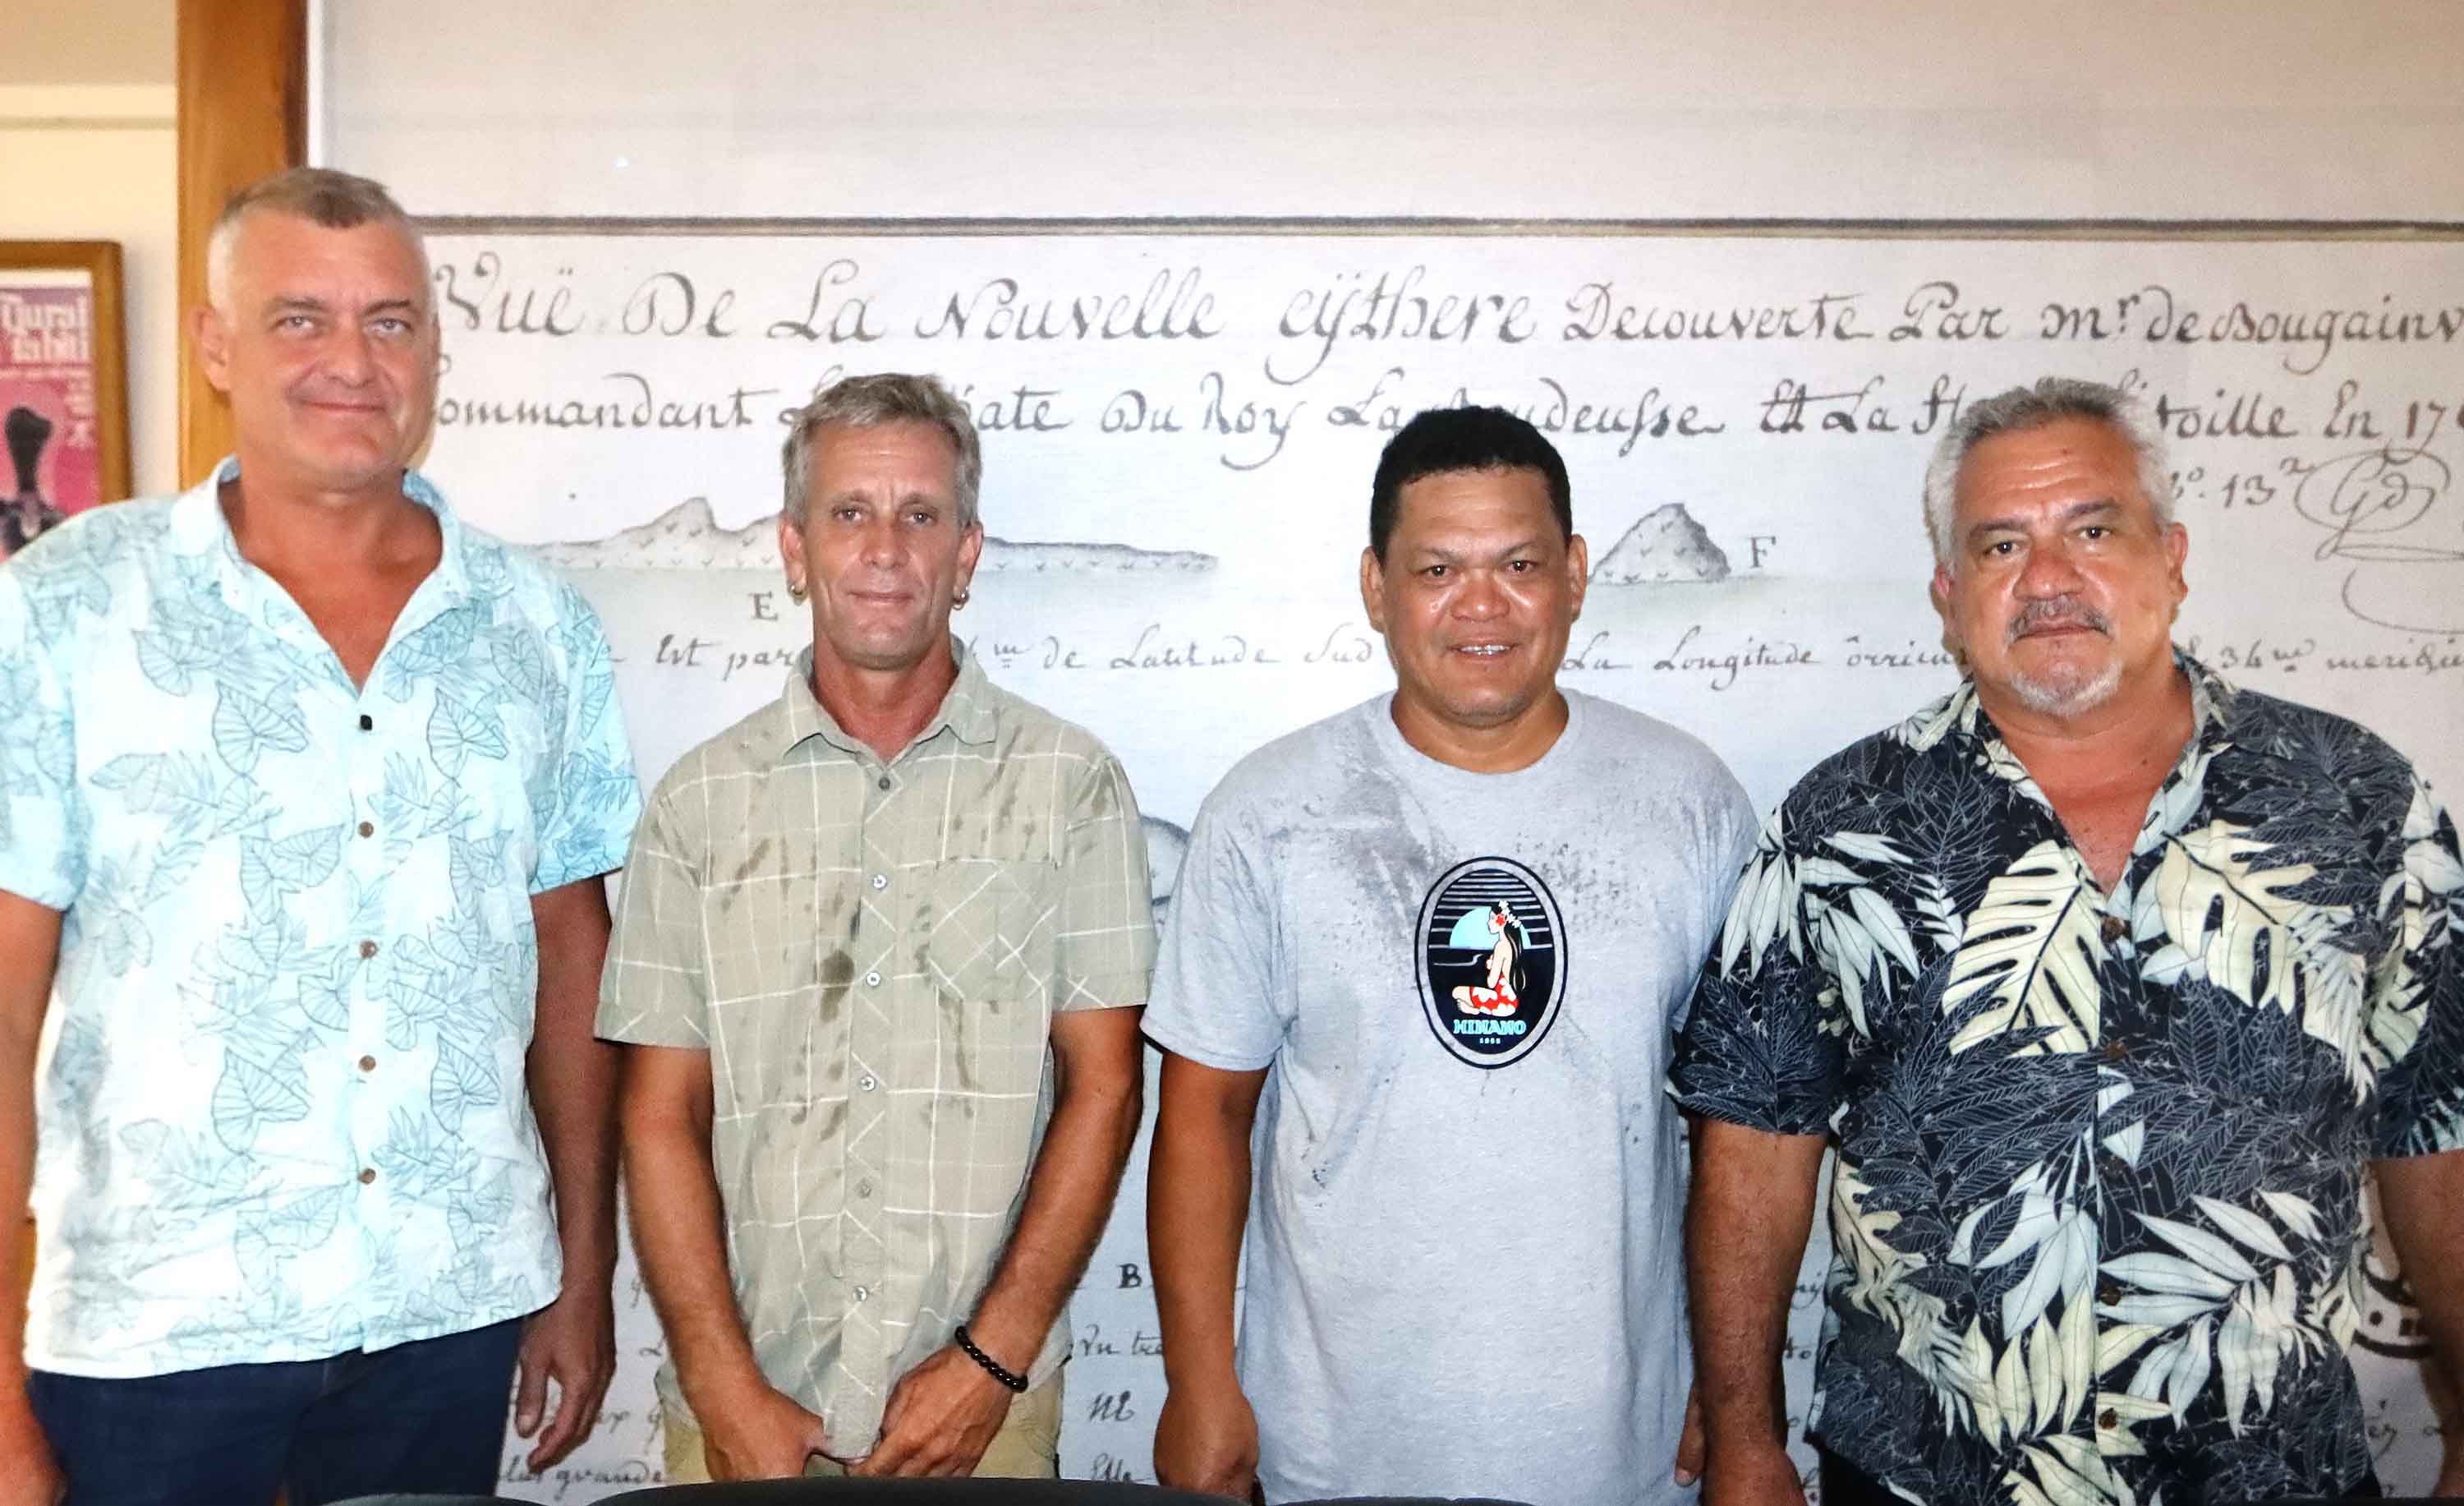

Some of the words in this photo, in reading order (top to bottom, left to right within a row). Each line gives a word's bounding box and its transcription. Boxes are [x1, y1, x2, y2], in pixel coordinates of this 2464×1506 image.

[622, 272, 737, 338] De
[768, 259, 888, 343] La
[915, 266, 1227, 342] Nouvelle
[439, 353, 780, 429] ommandant
[1748, 536, 1777, 568] F
[748, 591, 779, 622] E
[1453, 1020, 1527, 1035] HINANO
[1117, 1263, 1142, 1289] B
